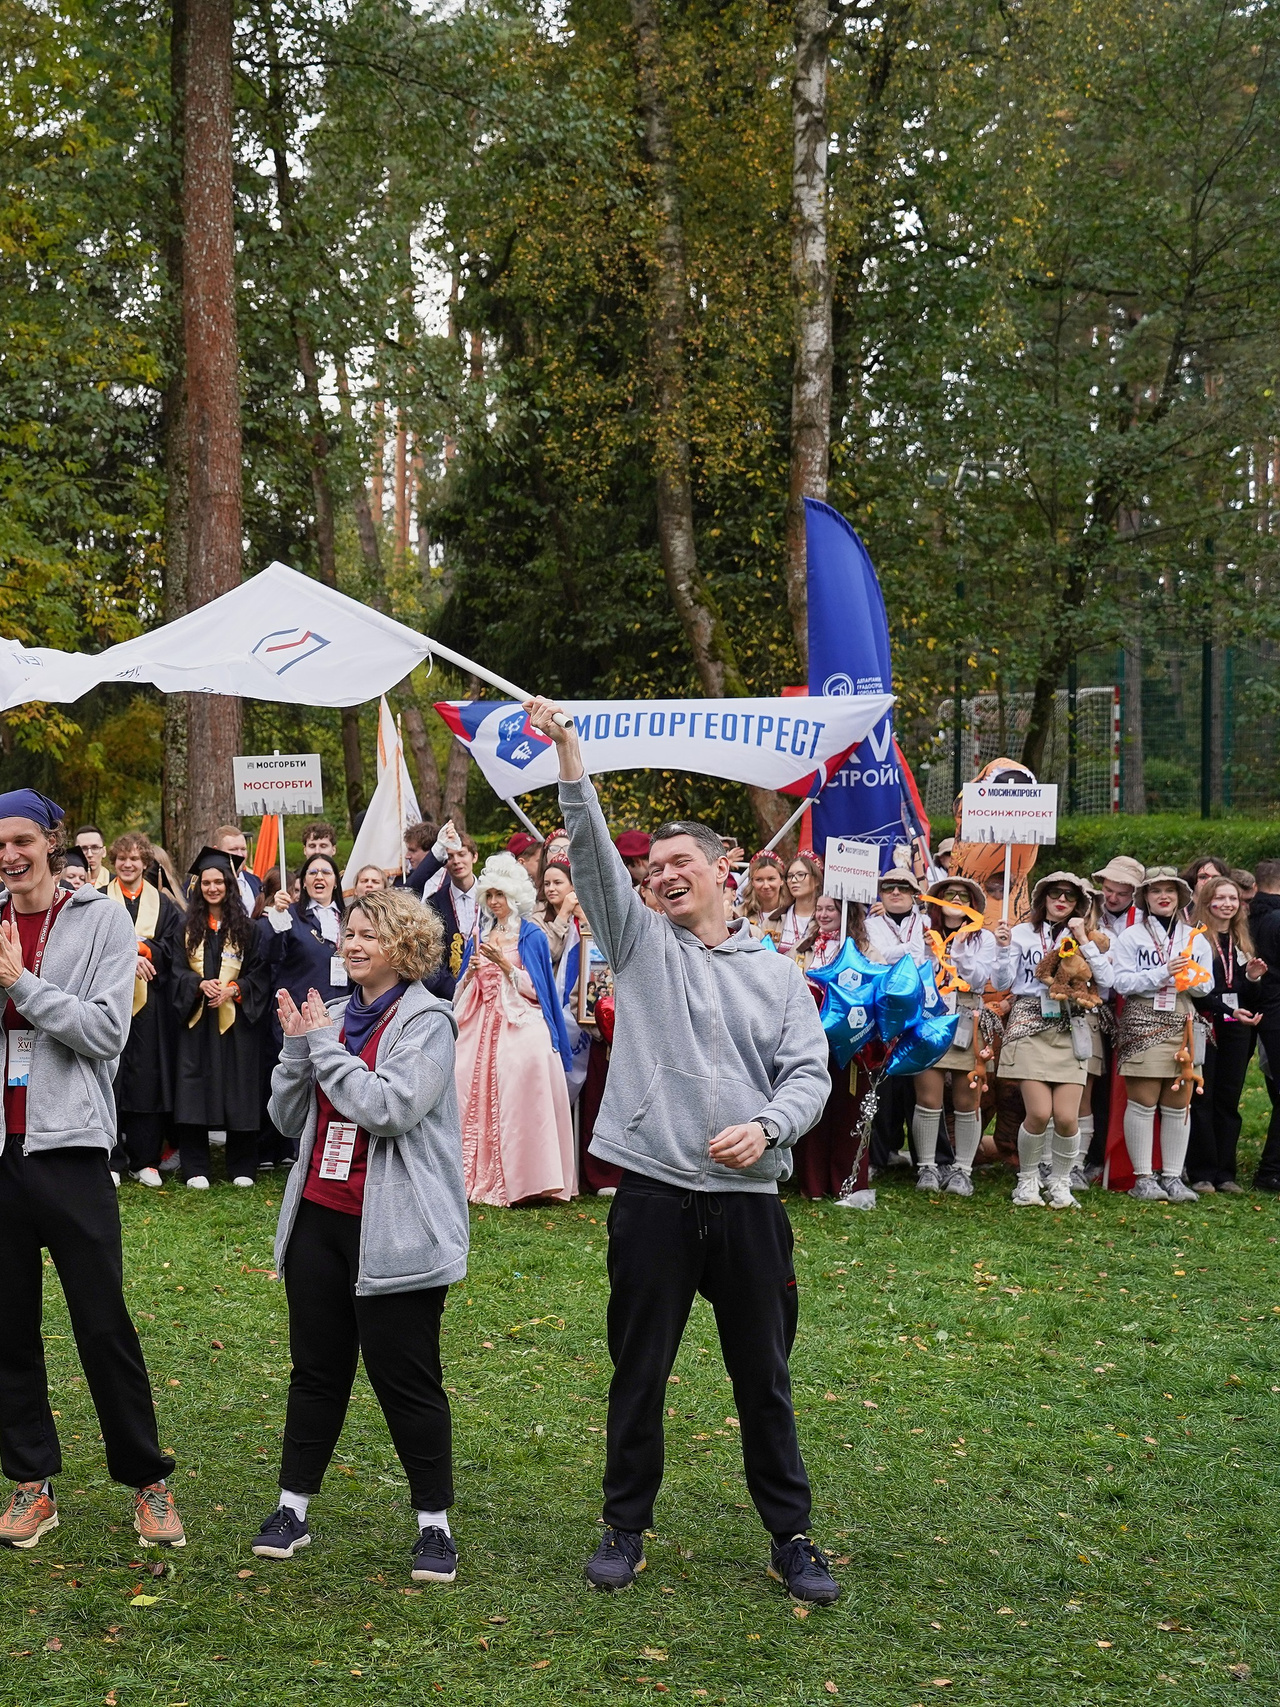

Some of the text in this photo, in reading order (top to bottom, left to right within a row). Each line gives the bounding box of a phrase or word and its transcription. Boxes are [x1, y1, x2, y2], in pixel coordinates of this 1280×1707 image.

[573, 712, 825, 759] МОСГОРГЕОТРЕСТ
[256, 760, 307, 769] МОСГОРБТИ
[243, 780, 313, 790] МОСГОРБТИ
[988, 788, 1042, 797] МОСИНЖПРОЕКТ
[968, 809, 1054, 818] МОСИНЖПРОЕКТ
[828, 865, 876, 878] МОСГОРГЕОТРЕСТ
